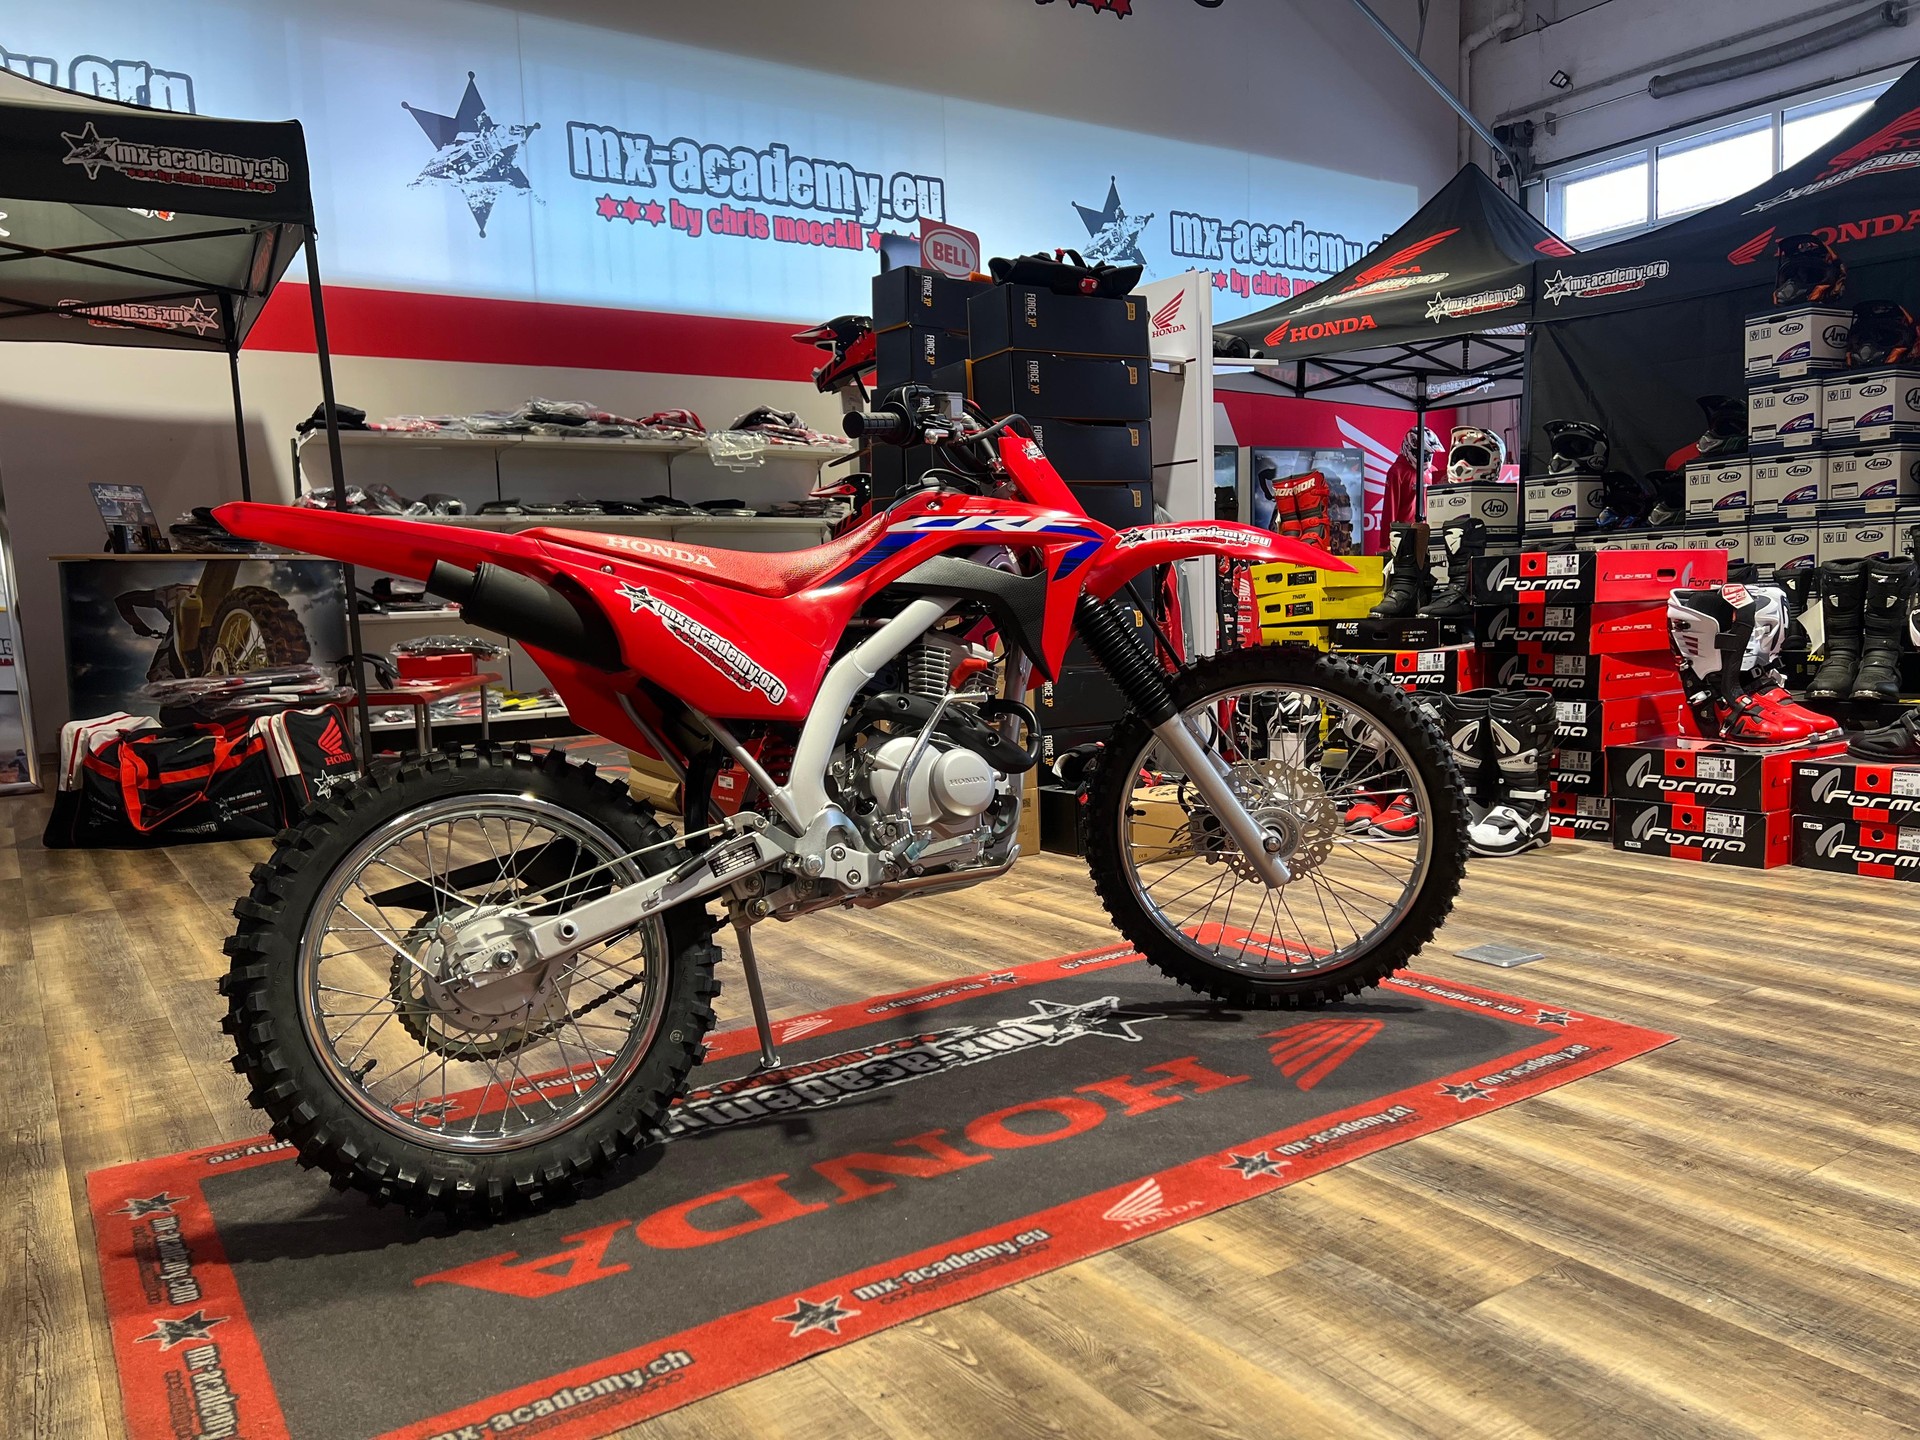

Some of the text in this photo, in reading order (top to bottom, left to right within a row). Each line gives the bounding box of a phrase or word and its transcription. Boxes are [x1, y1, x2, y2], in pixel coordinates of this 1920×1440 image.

[115, 143, 288, 181] mx-academy.ch
[567, 121, 946, 228] mx-academy.eu
[669, 198, 864, 251] by chris moeckli
[1775, 209, 1920, 256] ONDA
[932, 240, 971, 270] BELL
[1229, 267, 1250, 298] by
[1252, 268, 1291, 298] chris
[1569, 259, 1669, 291] mx-academy.org
[923, 275, 933, 307] FORCE XP
[1447, 284, 1525, 311] mx-academy.ch
[1026, 293, 1037, 328] FORCE XP
[1151, 324, 1187, 338] HONDA
[1290, 315, 1378, 343] HONDA
[926, 334, 936, 365] FORCE XP
[1029, 360, 1040, 395] FORCE XP
[886, 515, 1093, 533] CRF
[606, 536, 717, 569] HONDA
[1496, 577, 1581, 592] Forma
[1336, 622, 1359, 630] BLITZ
[1496, 627, 1576, 642] Forma
[657, 601, 786, 703] mx-academy.org
[1506, 673, 1585, 689] Forma
[1044, 697, 1053, 707] XP
[1044, 735, 1055, 767] FORCE XP
[949, 775, 987, 787] HONDA
[1638, 775, 1737, 796] Forma
[1824, 789, 1920, 812] Form
[1644, 827, 1747, 853] Forma
[413, 1057, 1252, 1298] HONDA
[1121, 1199, 1204, 1231] HONDA
[851, 1227, 1053, 1302] mx-academy.eu
